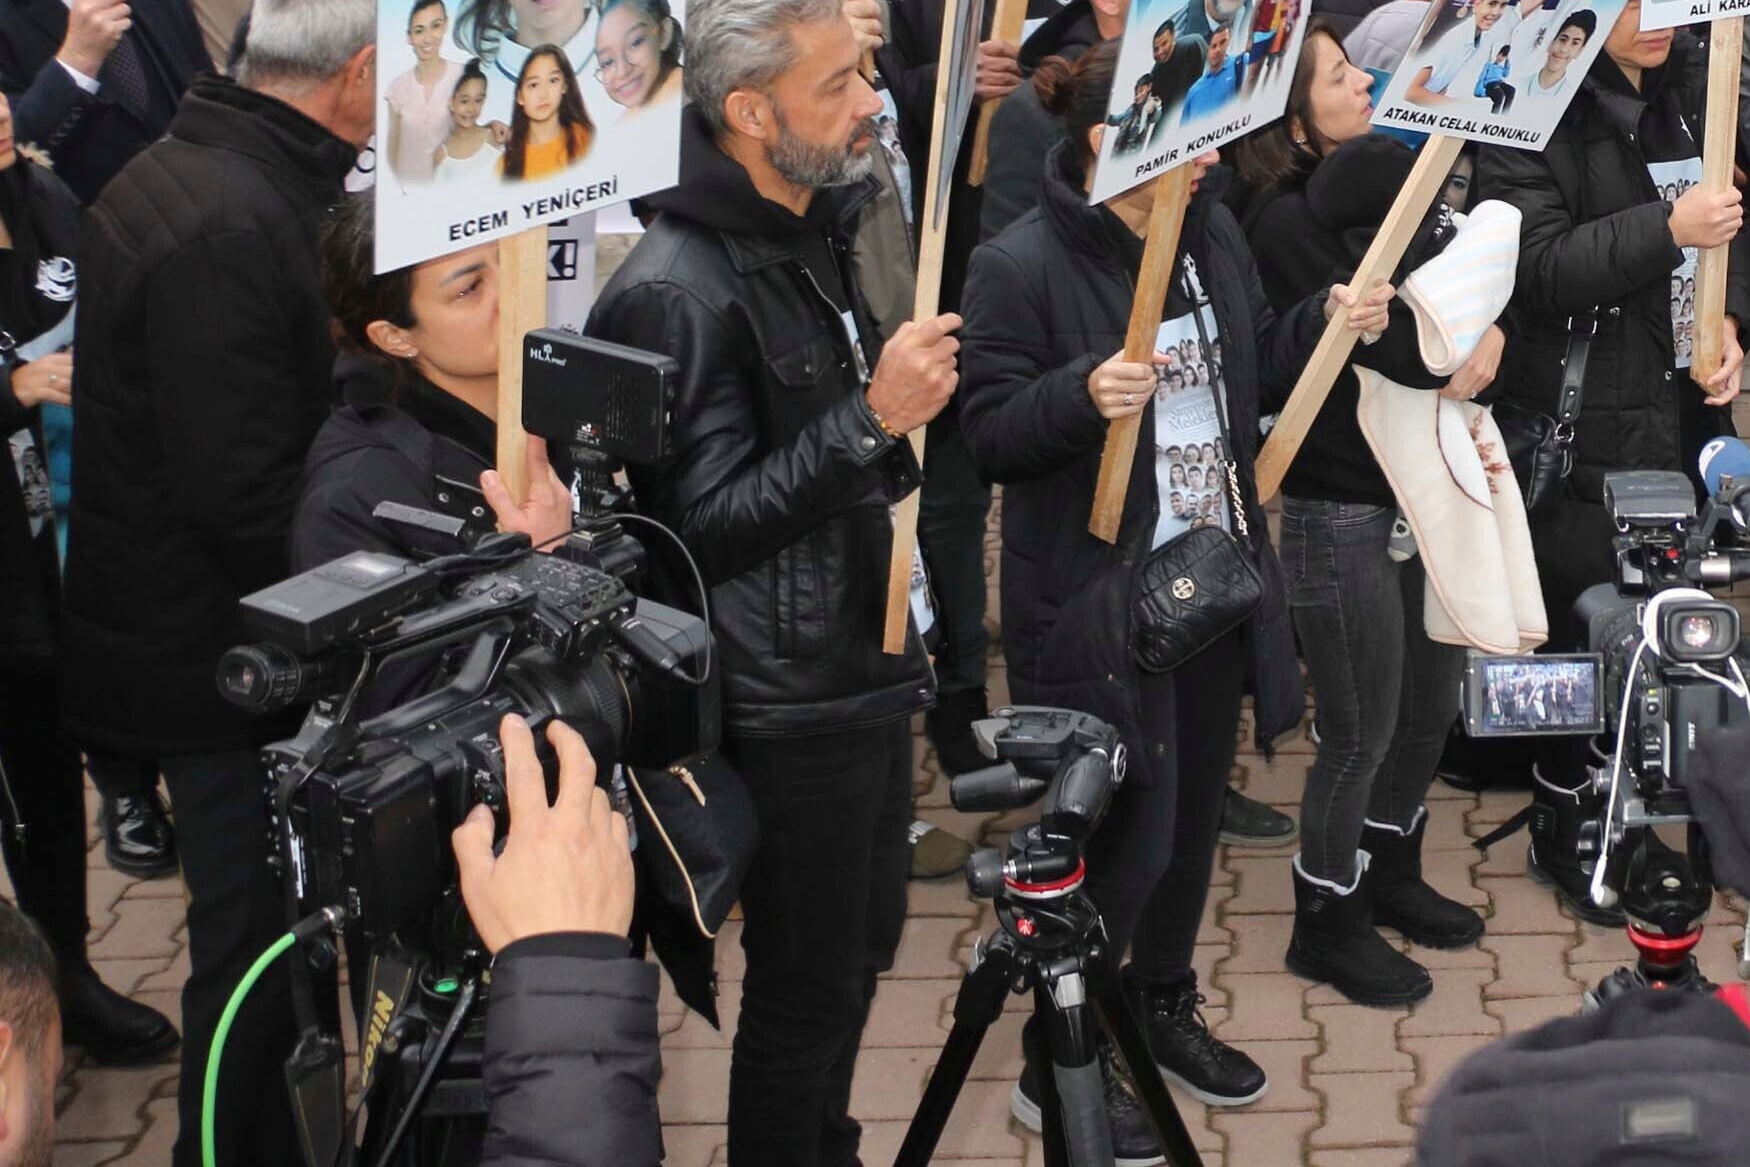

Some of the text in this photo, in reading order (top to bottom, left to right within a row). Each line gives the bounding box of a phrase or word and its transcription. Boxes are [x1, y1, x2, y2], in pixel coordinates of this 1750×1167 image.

[1689, 1, 1711, 17] ALİ
[1134, 114, 1252, 177] PAMİR KONUKLU
[1383, 106, 1541, 145] ATAKAN CELAL KONUKLU
[449, 175, 619, 242] ECEM YENİÇERİ
